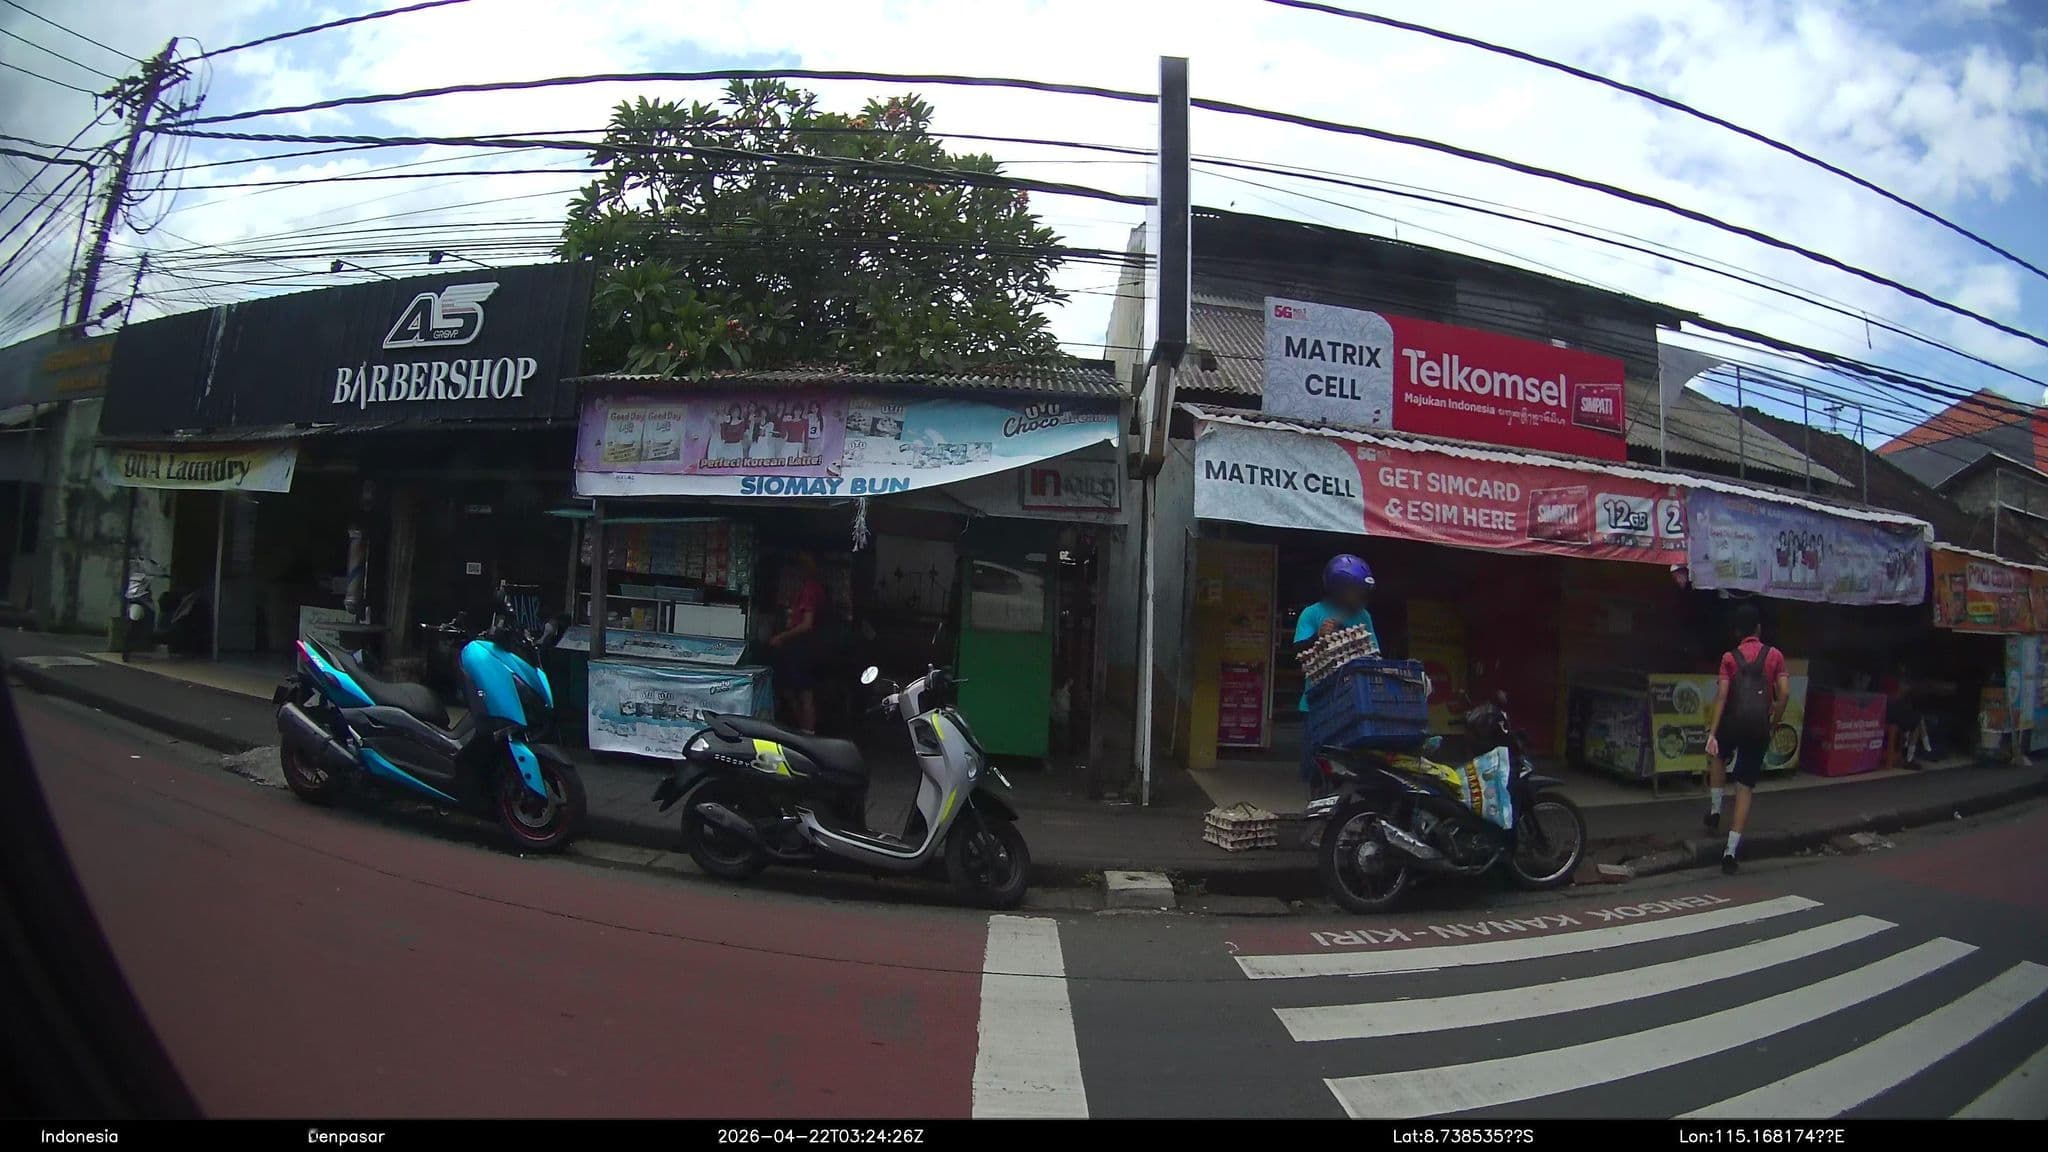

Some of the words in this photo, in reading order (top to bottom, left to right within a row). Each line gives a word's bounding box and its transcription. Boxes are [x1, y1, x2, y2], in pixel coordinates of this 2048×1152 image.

[1274, 304, 1292, 319] 5G
[1285, 335, 1382, 369] MATRIX
[332, 356, 538, 410] BARBERSHOP
[1305, 373, 1361, 400] CELL
[1402, 348, 1567, 408] Telkomsel
[1404, 392, 1447, 408] Majukan
[1448, 397, 1496, 416] Indonesia
[1003, 416, 1060, 438] Choco
[166, 454, 251, 486] Laundry
[698, 457, 740, 469] Perfect
[742, 457, 786, 468] Korean
[740, 476, 844, 495] SIOMAY
[850, 476, 910, 494] BUN
[1205, 459, 1298, 491] MATRIX
[1304, 473, 1356, 498] CELL
[1379, 466, 1424, 489] GET
[1427, 473, 1521, 502] SIMCARD
[1384, 498, 1403, 519] &
[1406, 500, 1460, 527] ESIM
[1463, 505, 1517, 531] HERE
[1586, 894, 1731, 922] TENGOK
